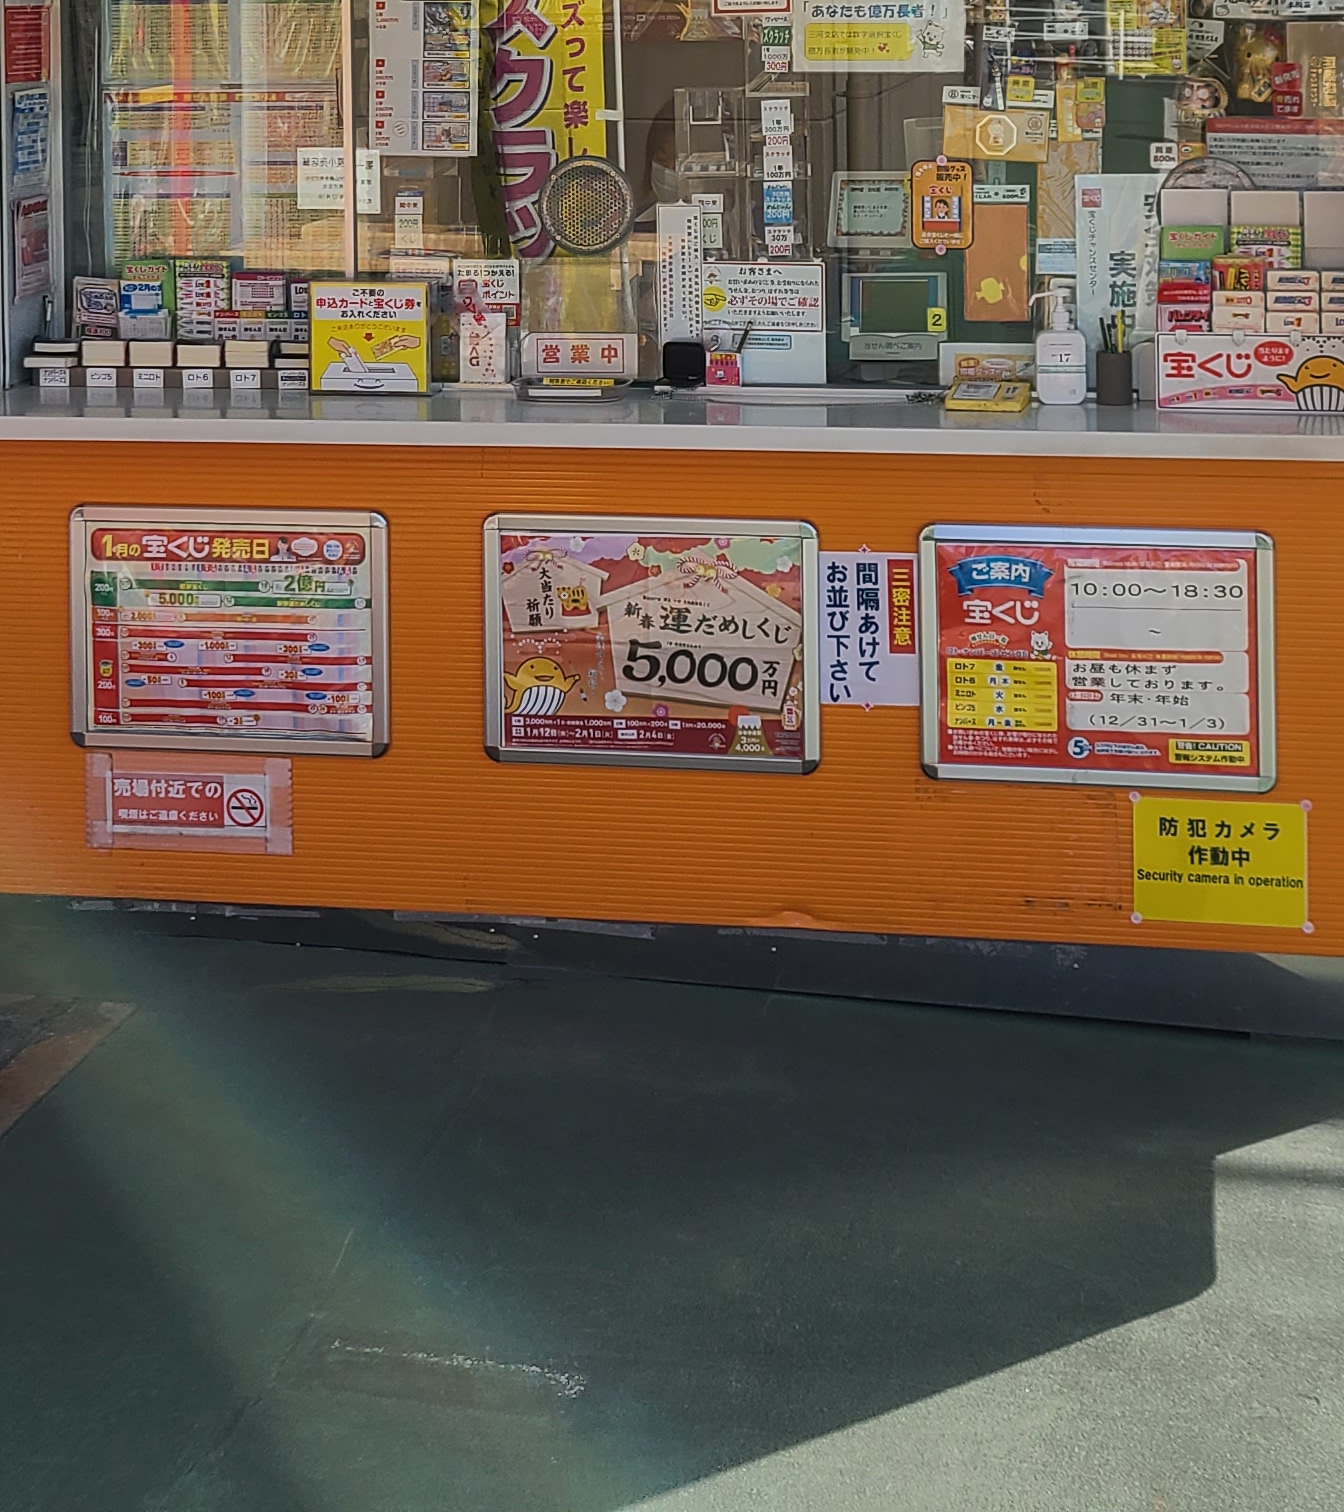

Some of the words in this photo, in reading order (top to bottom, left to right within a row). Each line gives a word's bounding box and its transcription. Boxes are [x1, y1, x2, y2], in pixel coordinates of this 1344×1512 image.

[767, 136, 789, 146] 200円
[928, 185, 953, 195] 宝くじ
[766, 210, 791, 219] 200円
[398, 218, 419, 230] 200円
[770, 244, 791, 255] 200円
[738, 266, 783, 276] お客さまへ
[315, 297, 422, 310] 申込カードと宝くじ券を
[481, 289, 516, 301] ポイント
[727, 295, 820, 308] 必ずその場でご確認
[340, 310, 398, 320] お入れください
[541, 343, 620, 365] 営業中
[1162, 351, 1253, 380] 宝くじ
[137, 372, 162, 382] ミニロト
[187, 373, 209, 383] ロト6
[235, 373, 257, 383] ロト7
[102, 533, 270, 559] 1月の宝くじ発売日
[970, 558, 1031, 583] ご案内
[538, 567, 555, 620] 大当たり
[1070, 582, 1244, 600] 10:00～18:30
[526, 598, 543, 627] 祈願
[891, 567, 913, 647] 三密注意
[962, 599, 1040, 626] 宝くじ
[623, 601, 792, 646] 新春運だめしくじ
[855, 561, 881, 684] 間隔あけて
[825, 561, 852, 704] お並び下さい
[622, 637, 760, 693] 5,000
[1072, 663, 1177, 676] お昼も休まず
[1071, 676, 1225, 693] 営業しております。
[1109, 692, 1190, 707] 年末・年始
[1197, 741, 1243, 753] CAUTION
[113, 776, 223, 800] 売場付近での
[1158, 816, 1283, 841] 防犯カメラ
[1187, 843, 1252, 869] 作動中
[1136, 867, 1184, 885] Security
[1187, 872, 1231, 886] camera
[1233, 872, 1245, 886] in
[1248, 874, 1304, 890] operation
